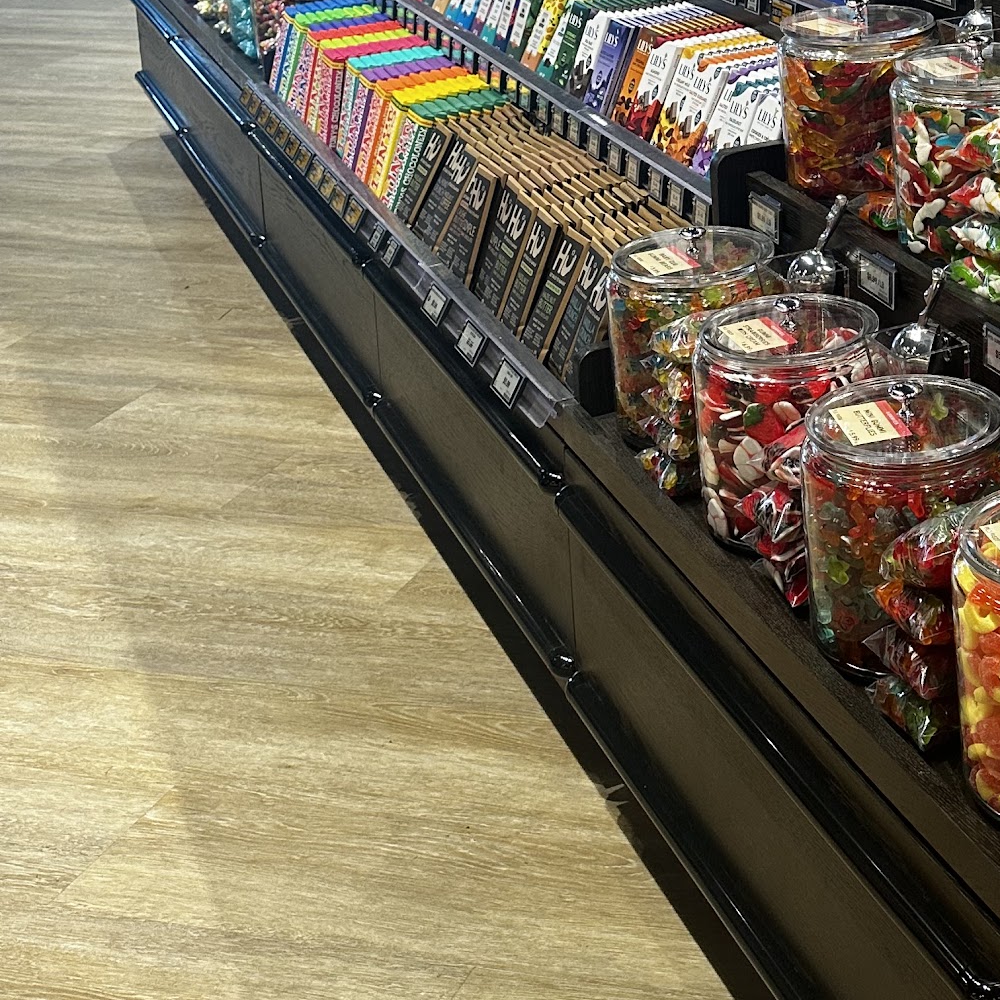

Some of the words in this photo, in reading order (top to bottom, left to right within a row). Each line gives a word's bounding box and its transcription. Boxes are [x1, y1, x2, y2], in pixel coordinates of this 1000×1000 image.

[650, 53, 668, 70] LILY'S
[678, 62, 694, 80] LILY'S
[693, 75, 712, 94] LILY'S
[729, 101, 749, 120] LILY'S
[757, 108, 778, 128] LILY'S
[403, 127, 428, 186] CHOCOLONELY
[853, 410, 877, 436] BUTTERFLIES
